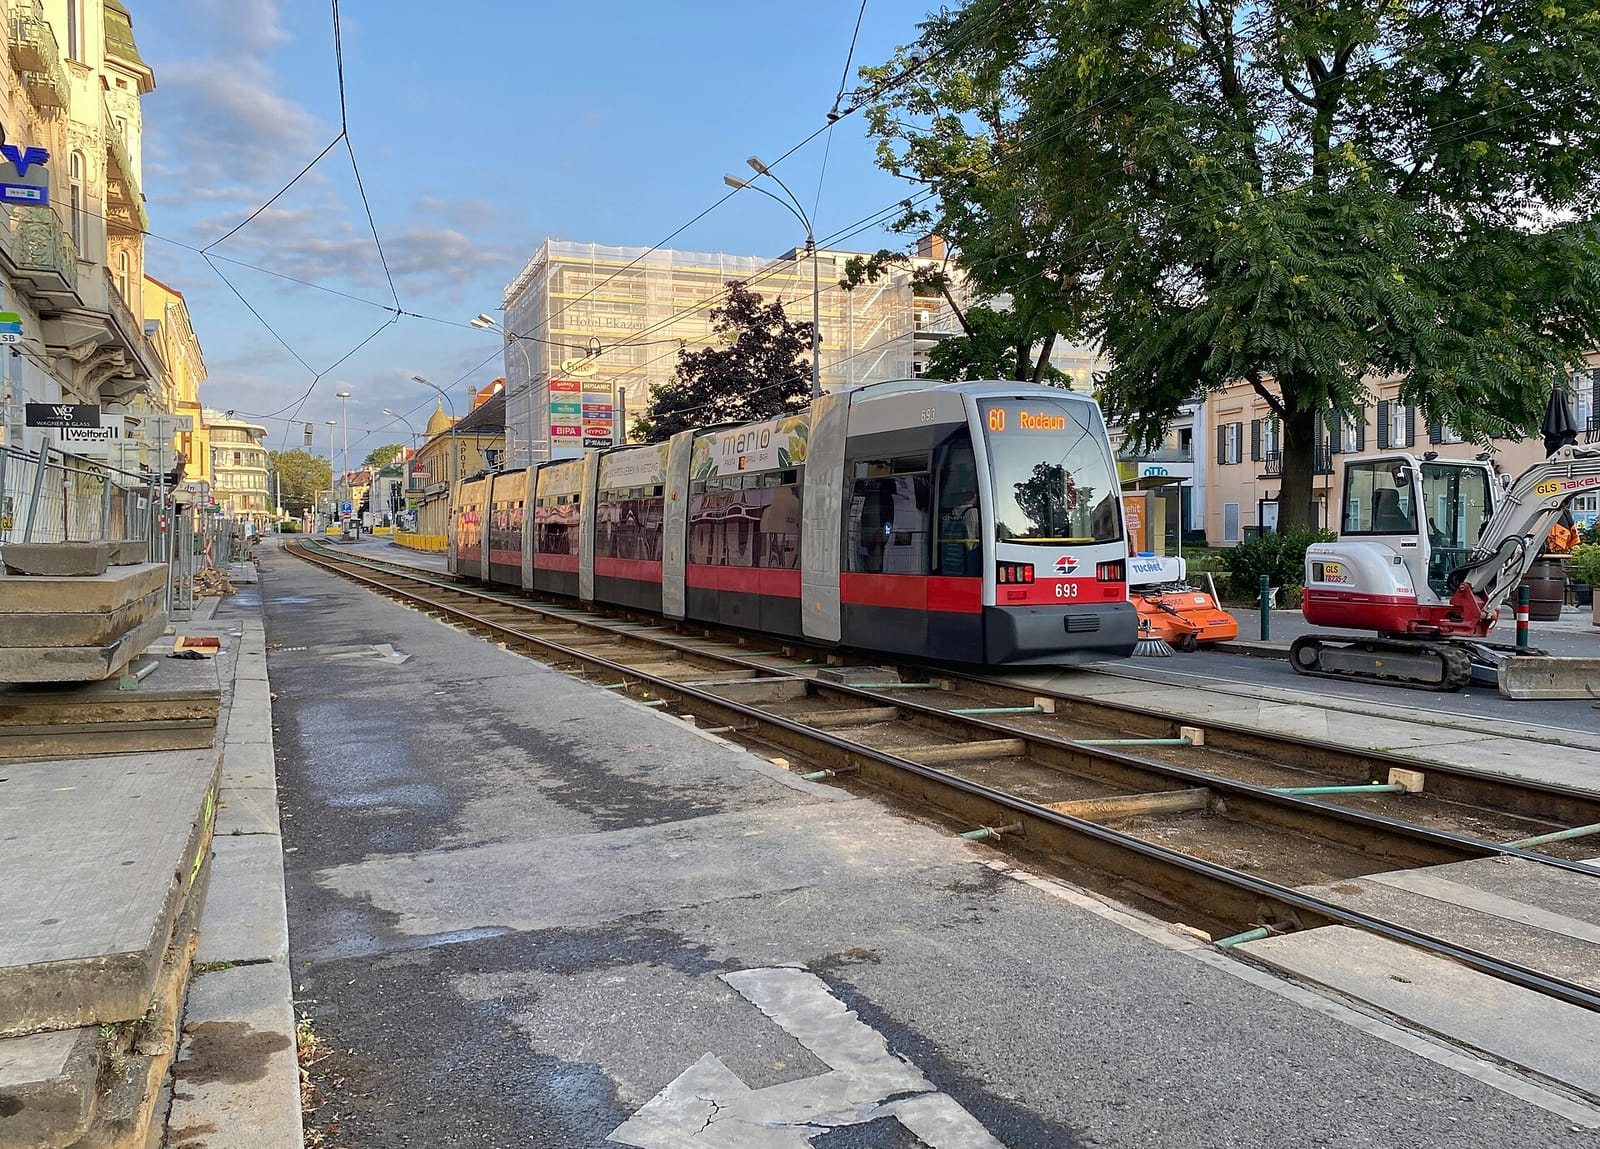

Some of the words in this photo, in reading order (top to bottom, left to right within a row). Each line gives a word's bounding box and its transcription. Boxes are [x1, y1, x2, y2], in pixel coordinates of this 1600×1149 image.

[569, 315, 600, 327] Hotel
[920, 408, 936, 423] 693
[988, 408, 1006, 431] 60
[1019, 411, 1066, 430] Rodaun
[70, 428, 109, 439] Wolford
[556, 427, 577, 435] BIPA
[1537, 483, 1558, 494] GLS
[1132, 563, 1164, 574] TUCHEL
[1325, 565, 1339, 573] GLS
[1055, 583, 1078, 598] 693
